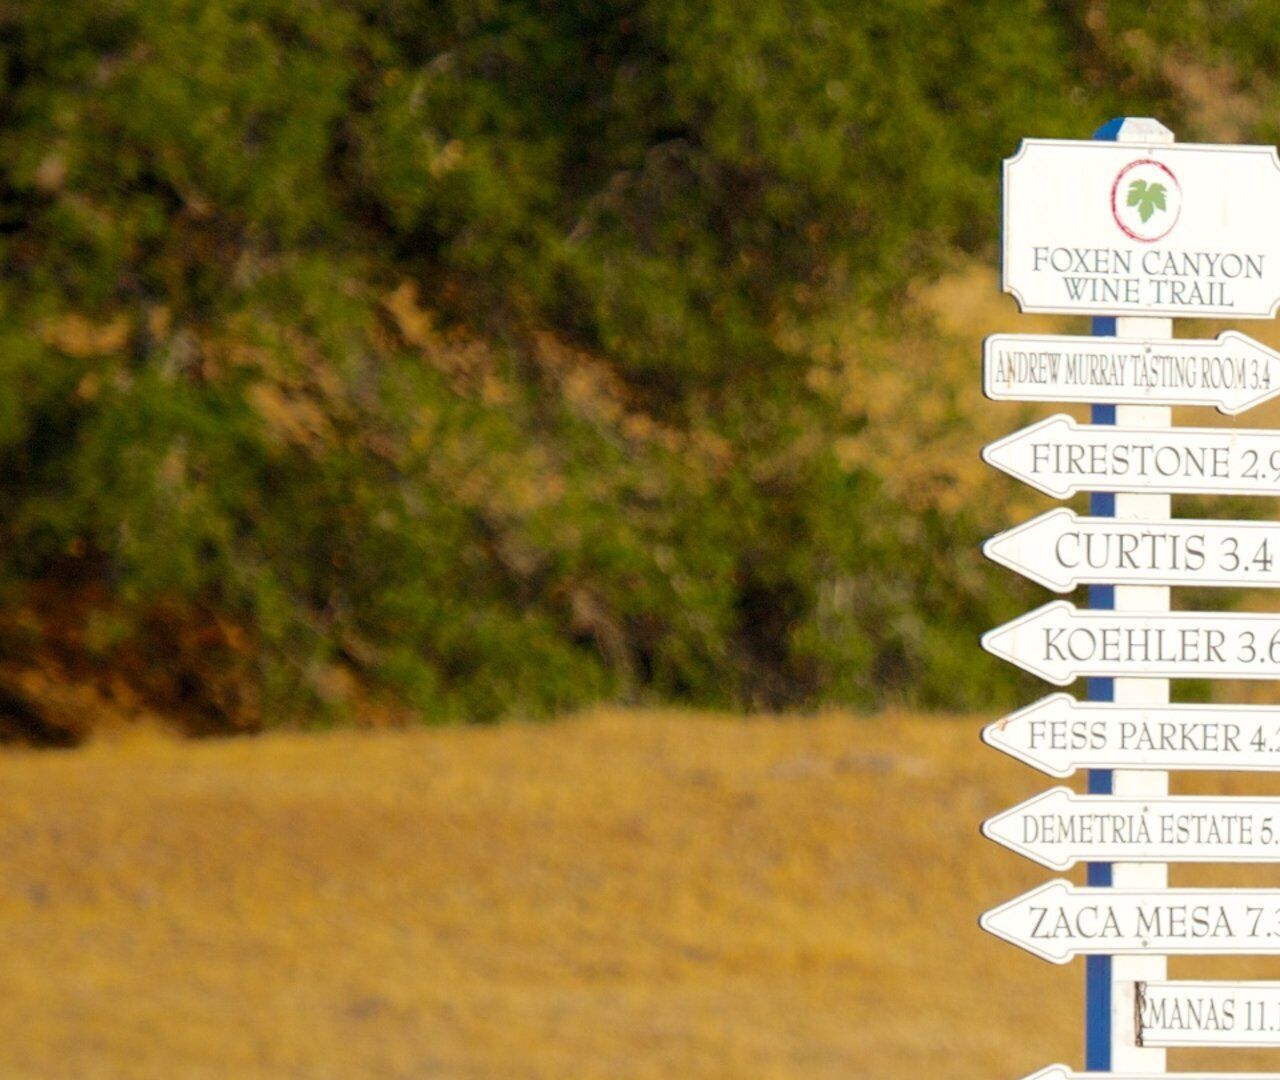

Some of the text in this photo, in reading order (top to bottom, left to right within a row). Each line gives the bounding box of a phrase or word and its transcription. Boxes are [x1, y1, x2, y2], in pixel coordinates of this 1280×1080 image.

[1033, 246, 1265, 279] FOXEN CANYON
[1063, 277, 1234, 307] WINE TRAIL
[996, 351, 1271, 390] ANDREW MURRAY TASTING ROOM 3.4
[1030, 443, 1230, 478] FIRESTONE
[1055, 532, 1273, 573] CURTIS 3.4
[1042, 627, 1227, 663] KOEHLER
[1028, 720, 1107, 749] FESS
[1119, 722, 1241, 752] PARKER
[1022, 814, 1153, 844] DEMETRIA
[1159, 815, 1253, 845] ESTATE
[1029, 906, 1125, 938] ZACA
[1136, 905, 1236, 938] MESA
[1143, 997, 1235, 1030] MANAS
